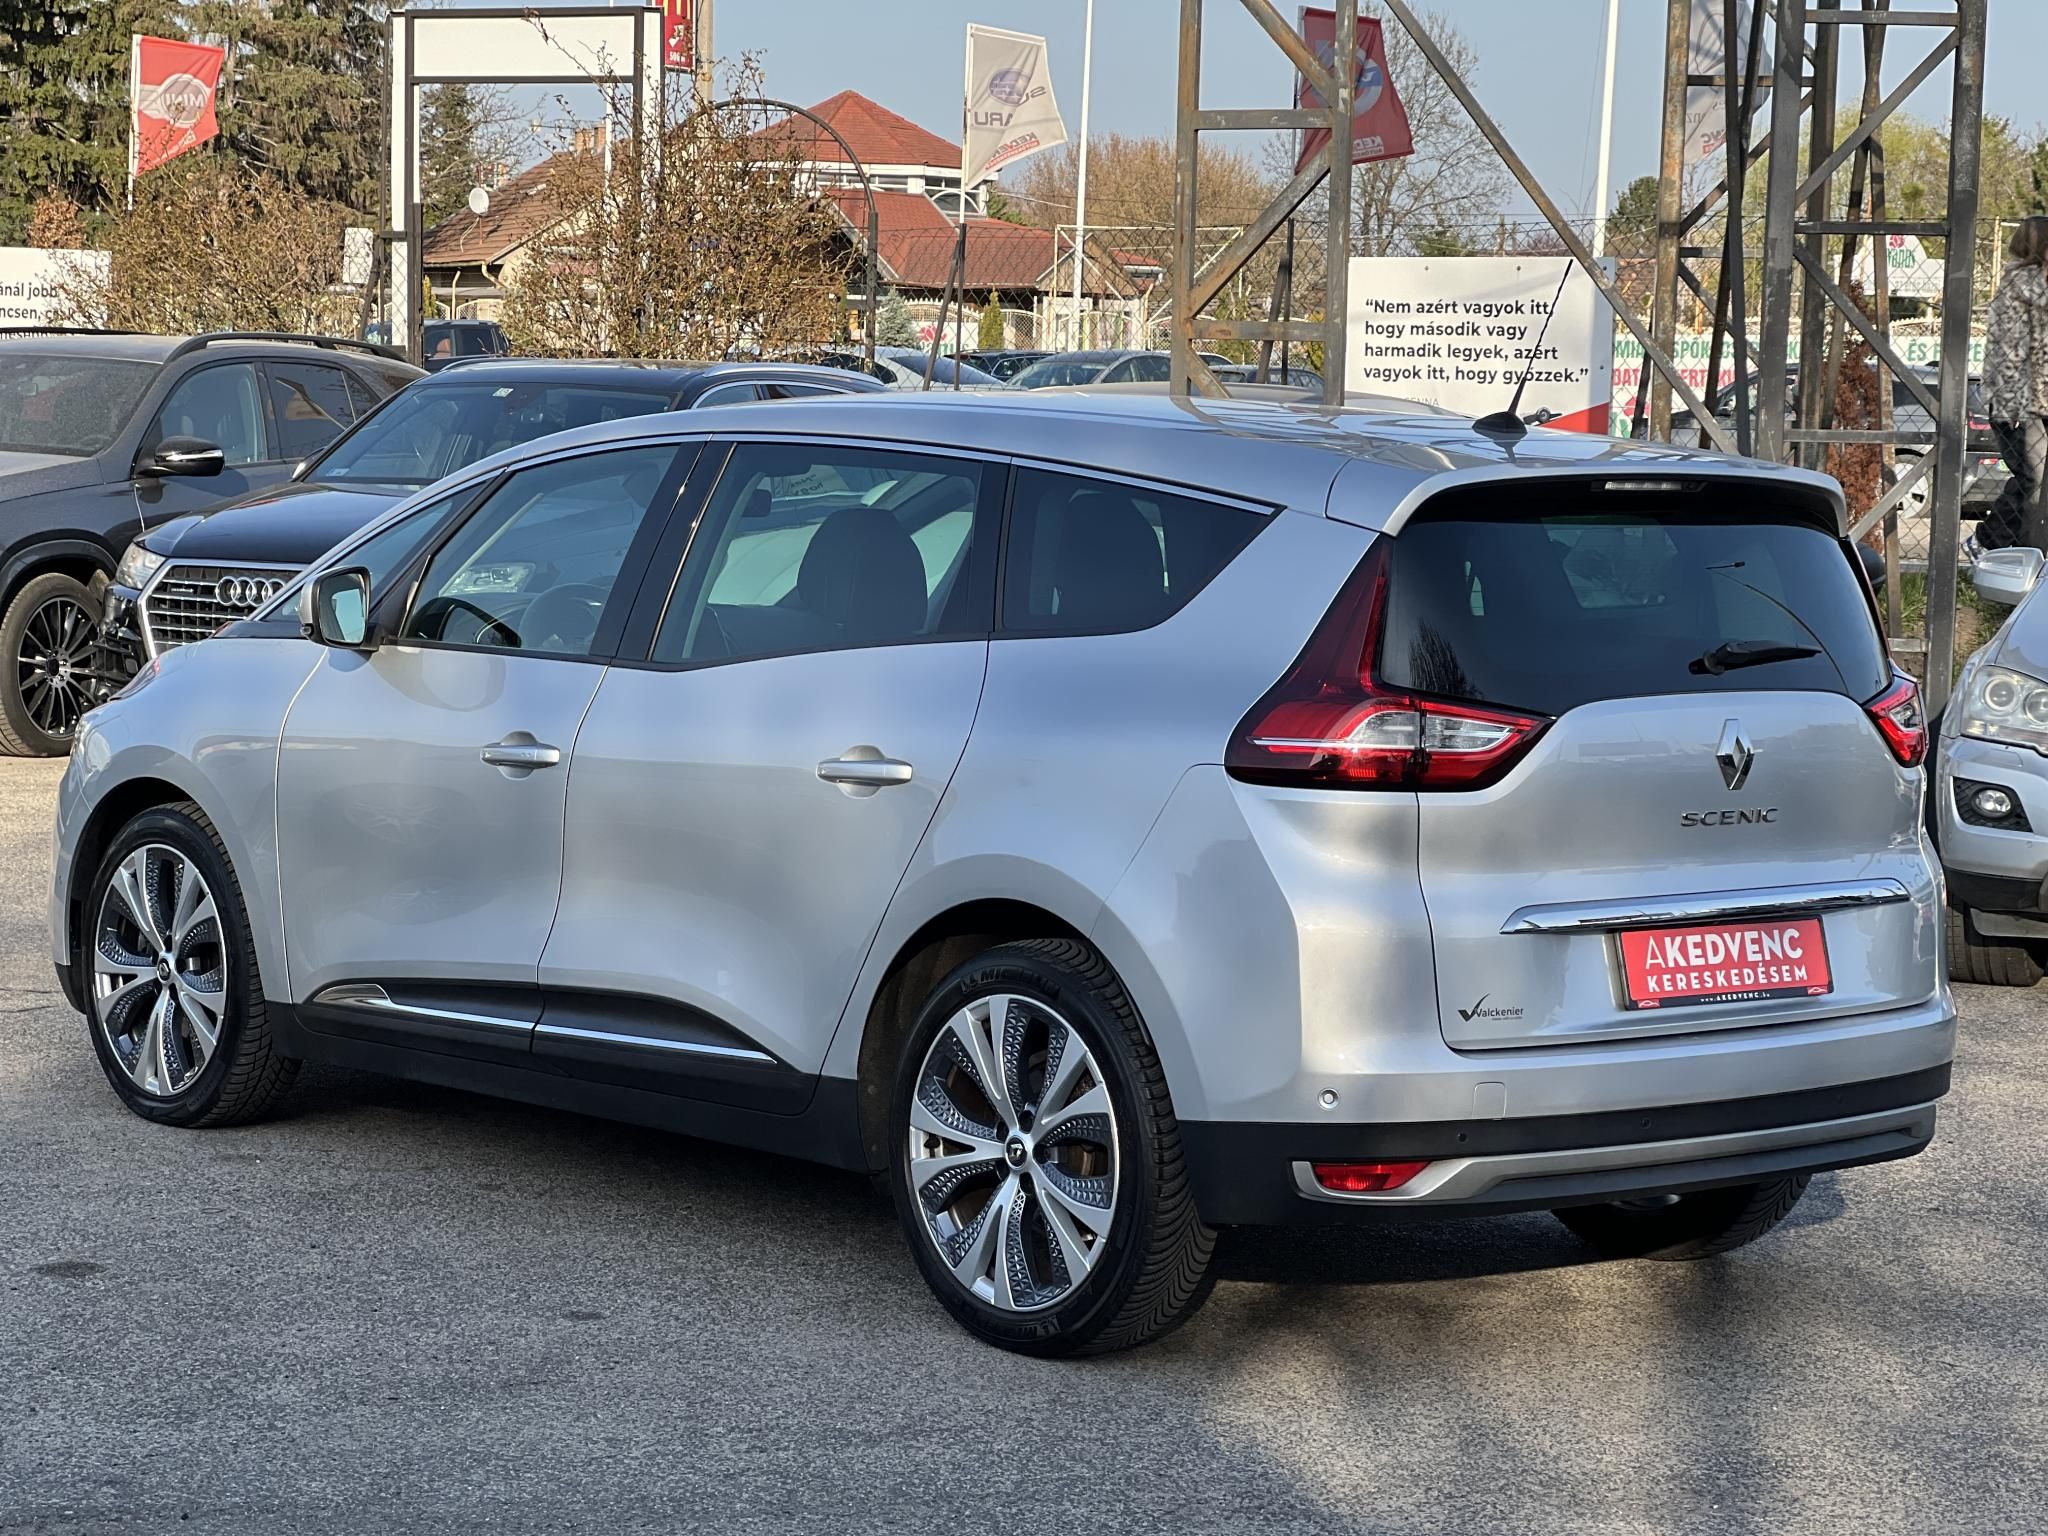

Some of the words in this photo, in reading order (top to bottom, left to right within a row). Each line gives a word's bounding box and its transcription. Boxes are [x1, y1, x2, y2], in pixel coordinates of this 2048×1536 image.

[27, 282, 58, 301] jobb
[1416, 299, 1458, 315] azért
[1463, 301, 1525, 318] vagyok
[1365, 321, 1405, 338] hogy
[1410, 321, 1481, 337] második
[1486, 326, 1528, 340] vagy
[1364, 343, 1442, 358] harmadik
[1447, 344, 1509, 361] legyek,
[1907, 339, 1927, 361] ÉS
[1363, 365, 1422, 382] vagyok
[1427, 365, 1450, 382] itt,
[1455, 366, 1498, 384] hogy
[1681, 808, 1778, 827] SCENIC
[1645, 928, 1804, 969] AKEDVENC
[1647, 962, 1808, 992] KERESKEDÉSEM
